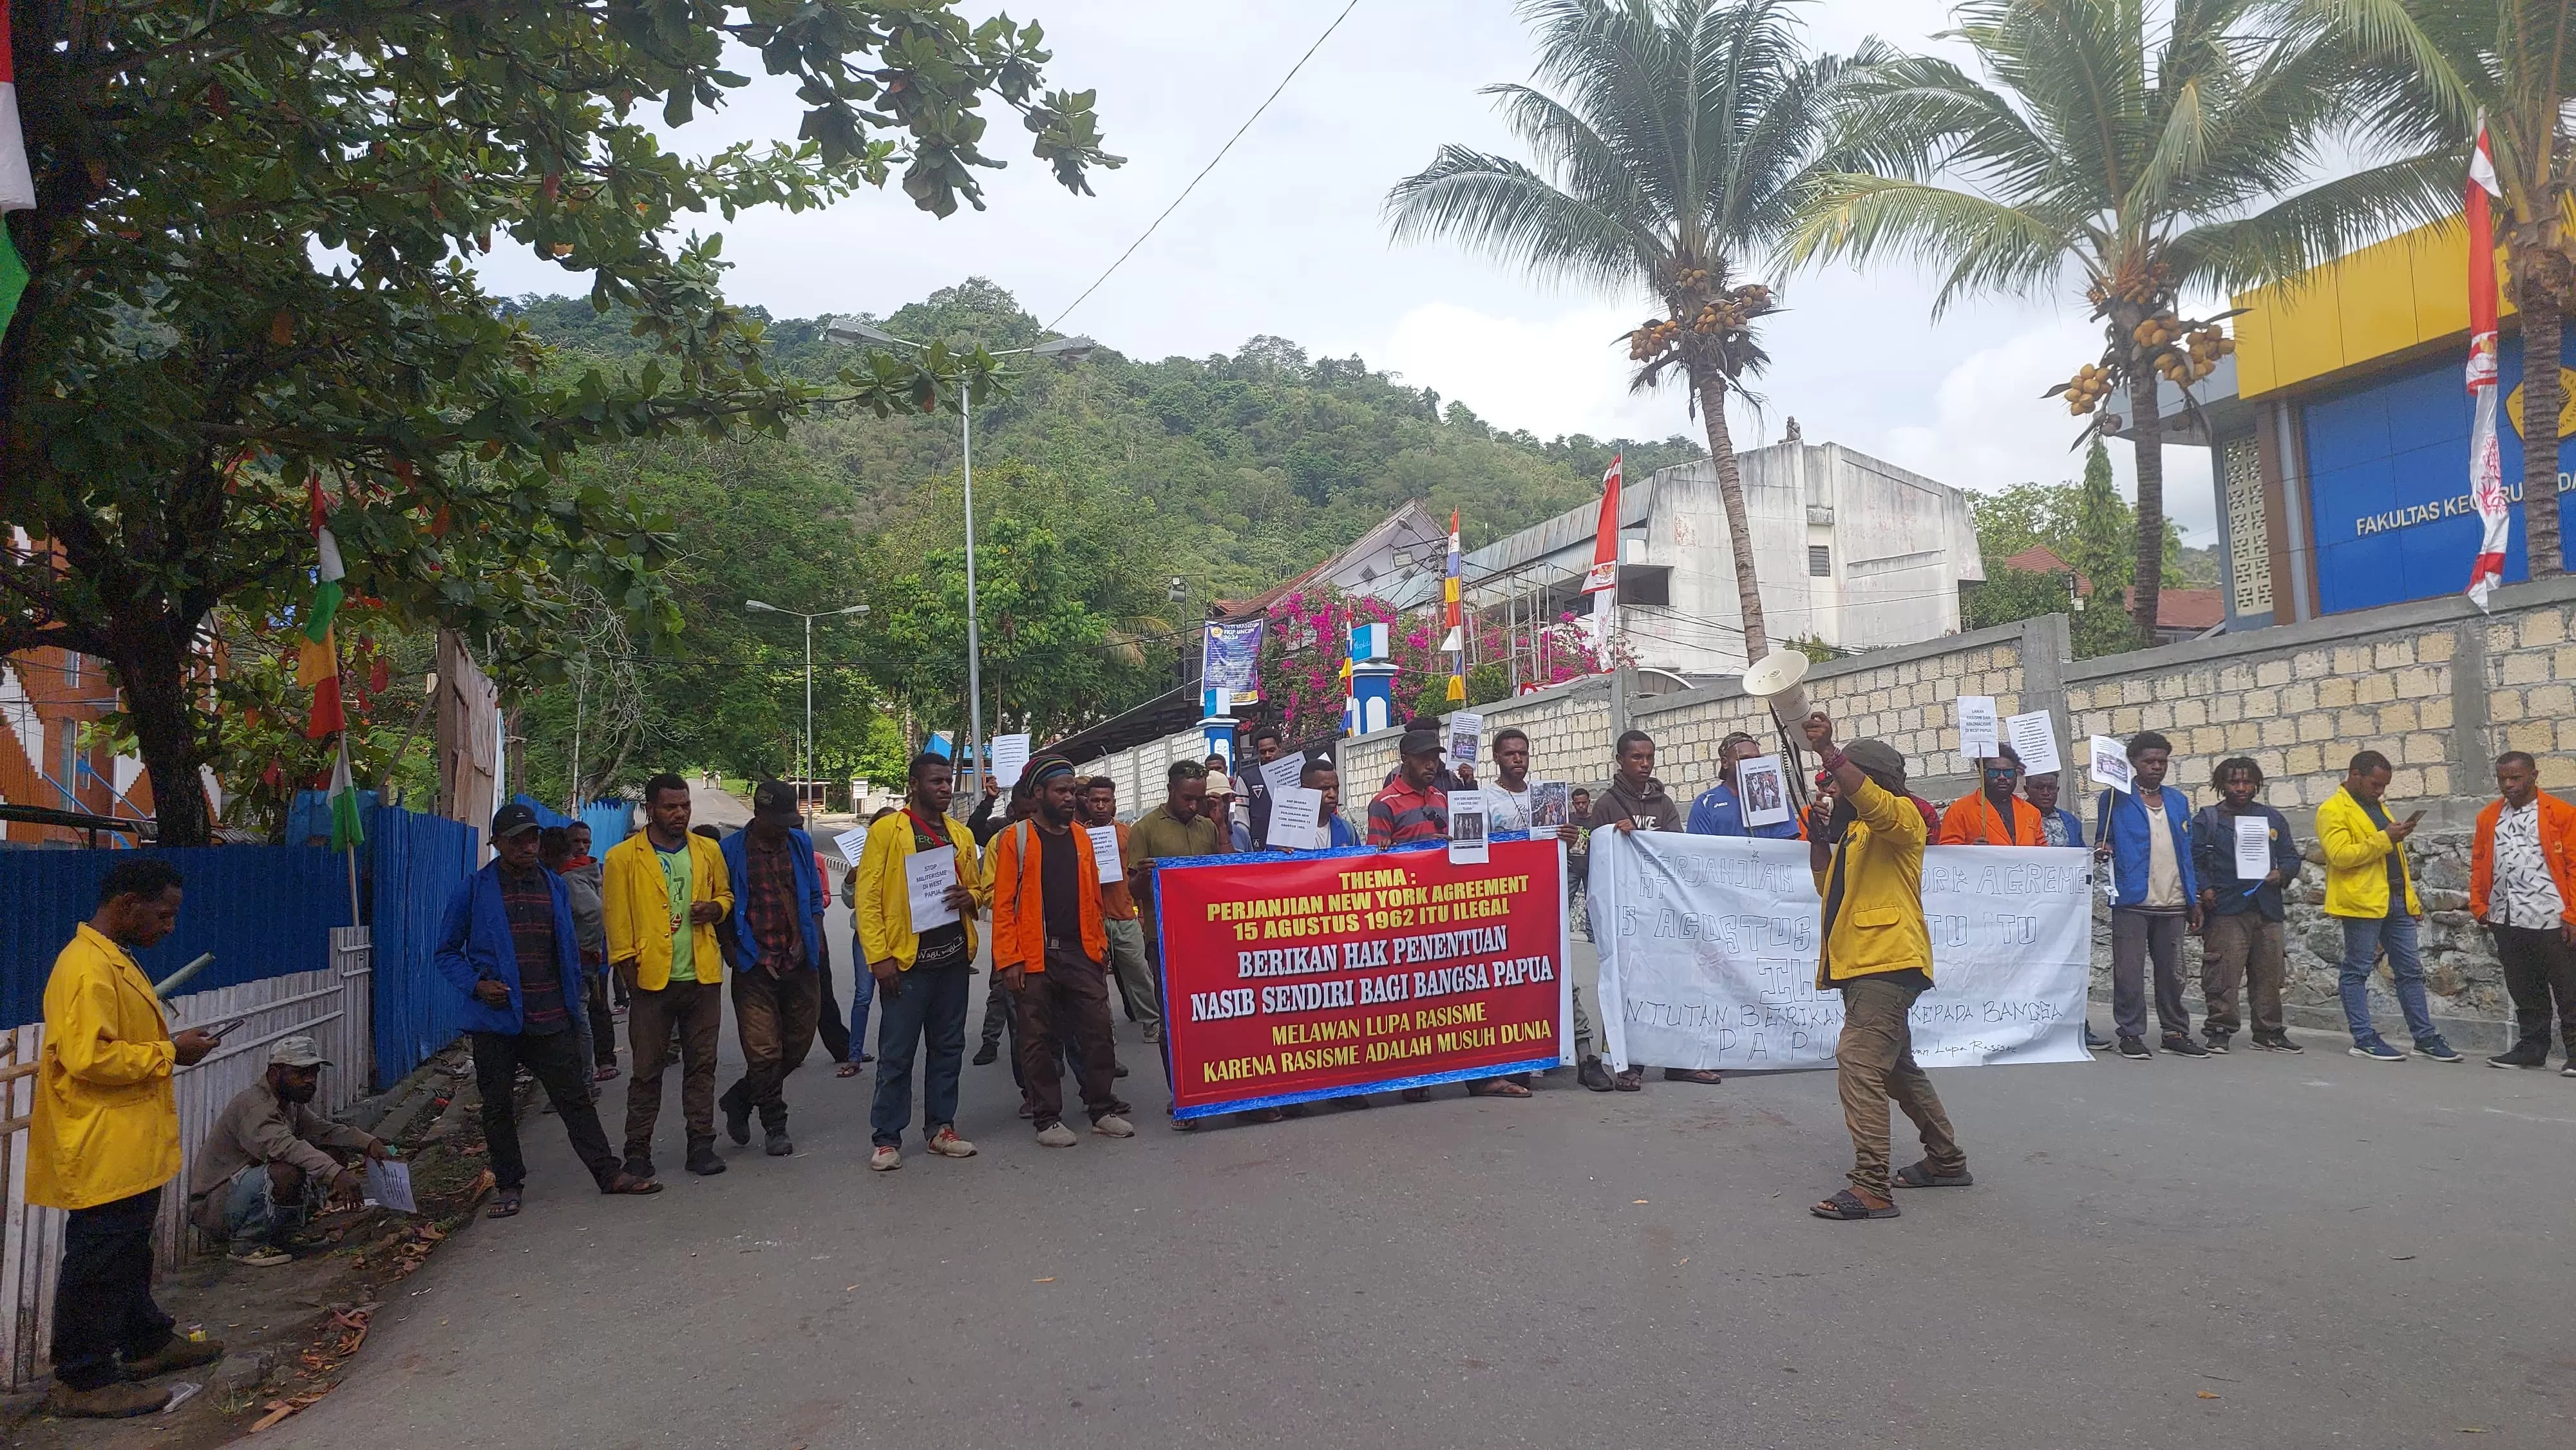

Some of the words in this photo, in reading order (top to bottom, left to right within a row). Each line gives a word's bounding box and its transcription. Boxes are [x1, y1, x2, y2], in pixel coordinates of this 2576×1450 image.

[2356, 501, 2440, 536] FAKULTAS
[916, 870, 947, 883] MILITERISME
[924, 863, 938, 872] STOP
[929, 880, 943, 889] WEST
[1339, 869, 1406, 890] THEMA
[1208, 896, 1323, 921] PERJANJIAN
[1329, 892, 1370, 912] NEW
[1375, 887, 1428, 908] YORK
[1432, 875, 1528, 903] AGREEMENT
[1233, 922, 1258, 940] 15
[1264, 914, 1359, 938] AGUSTUS
[1365, 909, 1414, 930] 1962
[1420, 905, 1448, 924] ITU
[1454, 898, 1510, 920] ILEGAL
[1654, 908, 1810, 954] AGUSTUS
[1924, 914, 1967, 947] TU
[1238, 945, 1337, 977] BERIKAN
[1343, 940, 1388, 969] HAK
[1393, 925, 1506, 964] PENENTUAN
[1191, 988, 1255, 1021] NASIB
[1262, 980, 1354, 1013] SENDIRI
[1359, 974, 1408, 1004] BAGI
[1414, 963, 1490, 997] BANGSA
[1492, 956, 1553, 986] PAPUA
[1273, 1019, 1359, 1046] MELAWAN
[1367, 1013, 1410, 1036] LUPA
[1416, 1003, 1486, 1030] RASISME
[1624, 997, 1728, 1027] NTUTAN
[1910, 1004, 1973, 1024] KEPADA
[1983, 1001, 2063, 1022] BANGSA
[1204, 1055, 1276, 1082] KARENA
[1282, 1046, 1360, 1072] RASISME
[1366, 1035, 1431, 1062] ADALAH
[1437, 1027, 1495, 1053] MUSUH
[1501, 1020, 1551, 1043] DUNIA
[1934, 1040, 1967, 1058] Lupa
